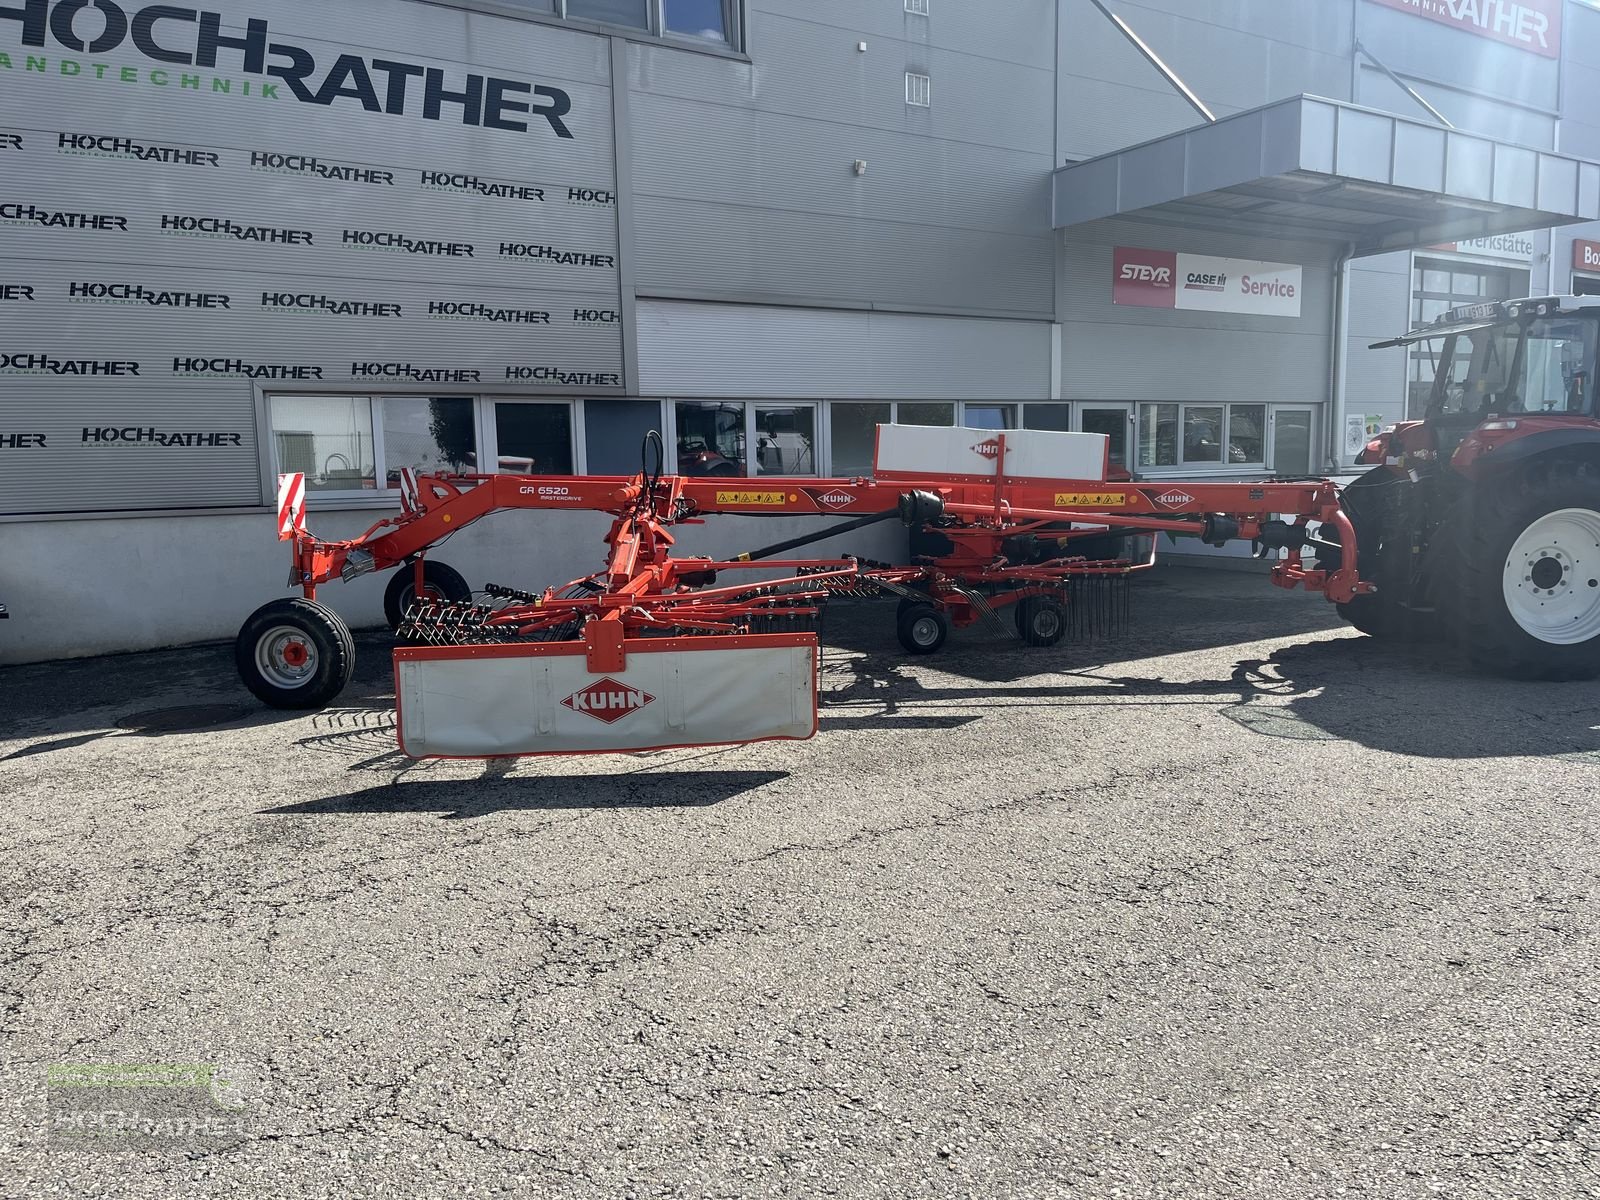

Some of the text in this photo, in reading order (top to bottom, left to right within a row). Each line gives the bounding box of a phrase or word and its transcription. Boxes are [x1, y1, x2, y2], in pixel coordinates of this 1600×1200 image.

[58, 133, 220, 167] HOCHRATHER
[251, 151, 394, 186] HOCHRATHER
[421, 171, 545, 201] HOCHRATHER
[161, 214, 313, 245] HOCHRATHER
[342, 229, 474, 257] HOCHRATHER
[499, 242, 614, 268] HOCHRATHER
[1120, 263, 1171, 283] STEYR
[1186, 272, 1217, 285] CASE
[69, 282, 231, 309] HOCHRATHER
[1241, 275, 1295, 298] Service
[261, 292, 402, 317] HOCHRATHER
[428, 301, 550, 324] HOCHRATHER
[173, 357, 323, 380] HOCHRATHER
[351, 362, 480, 383] HOCHRATHER
[505, 366, 619, 386] HOCHRATHER
[82, 427, 242, 446] HOCHRATHER
[519, 486, 569, 495] GA 6520
[823, 495, 851, 503] KUHN
[1160, 495, 1189, 503] KUHN
[572, 690, 645, 711] KUHN
